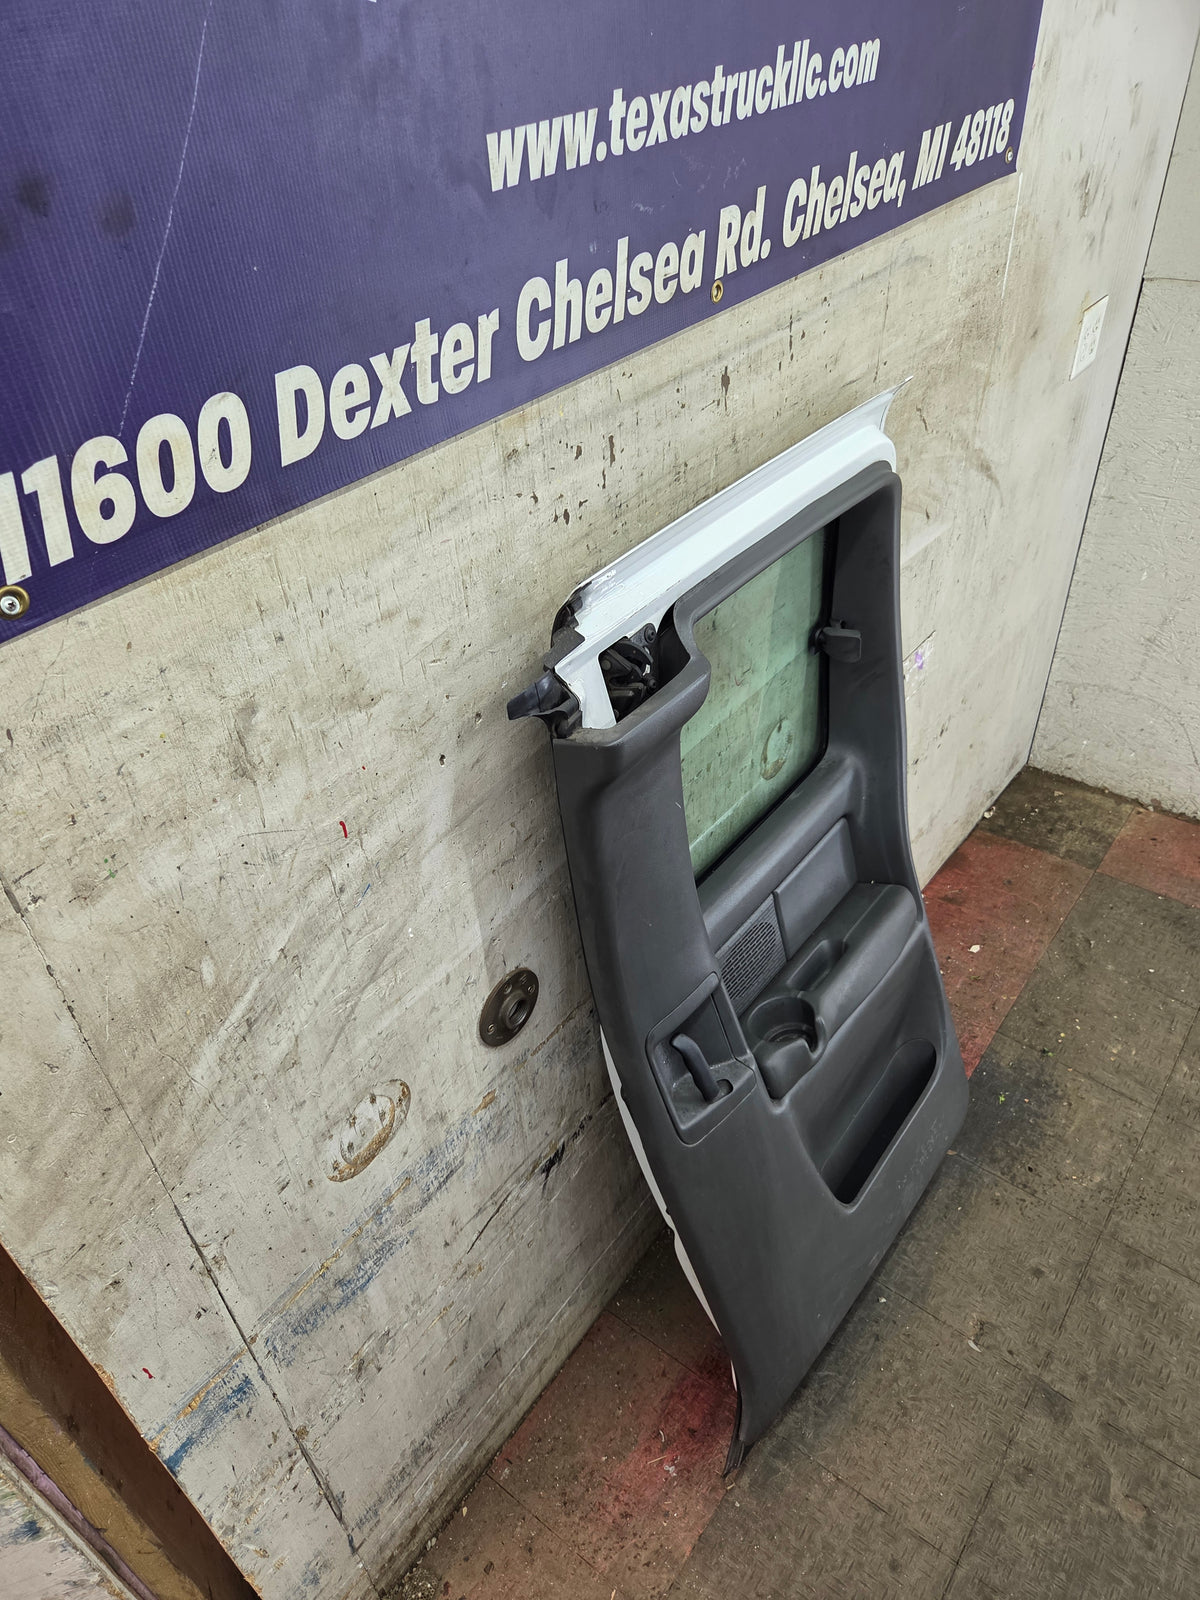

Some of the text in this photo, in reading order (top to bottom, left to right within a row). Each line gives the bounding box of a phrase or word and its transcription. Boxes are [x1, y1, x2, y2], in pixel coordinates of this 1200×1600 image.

[486, 37, 881, 193] www.texastruckllc.com
[0, 98, 1015, 586] 11600 Dexter Chelsea Rd. Chelsea, MI 48118
